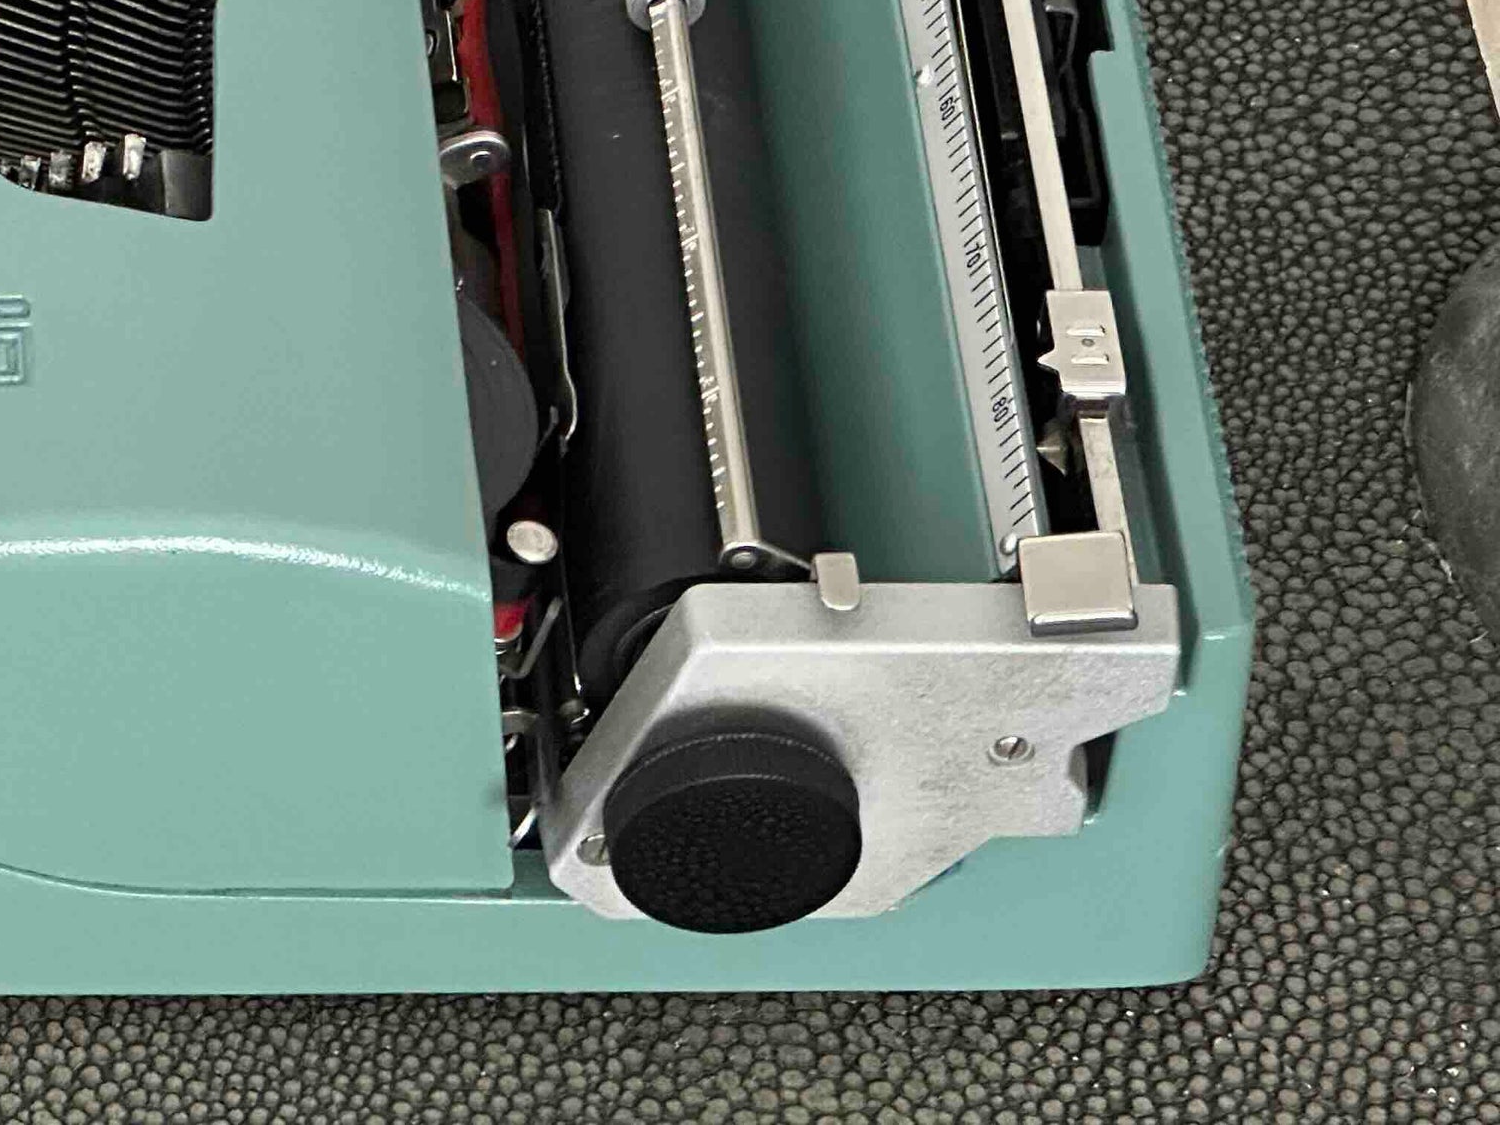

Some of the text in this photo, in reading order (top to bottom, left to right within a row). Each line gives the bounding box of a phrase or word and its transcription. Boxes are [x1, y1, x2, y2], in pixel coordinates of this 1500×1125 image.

[939, 96, 955, 121] 60
[965, 242, 981, 268] 70
[992, 396, 1009, 422] 80
